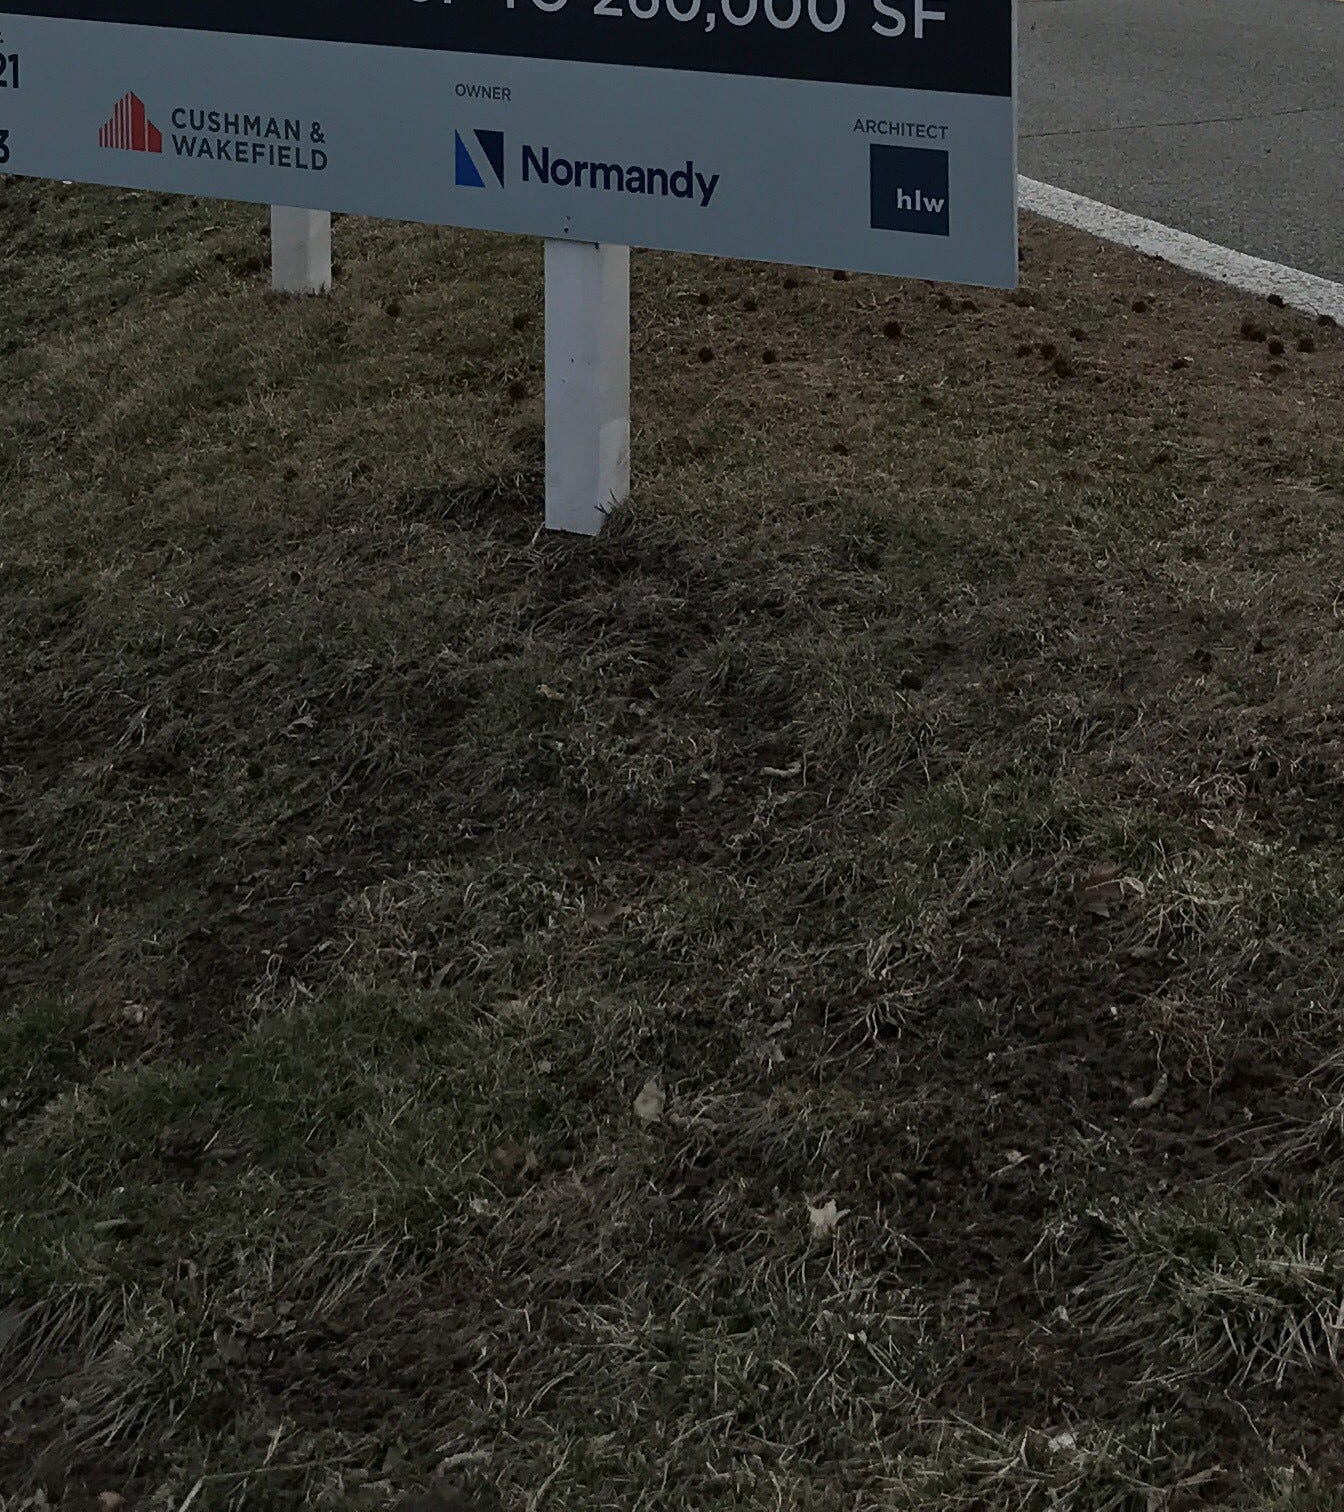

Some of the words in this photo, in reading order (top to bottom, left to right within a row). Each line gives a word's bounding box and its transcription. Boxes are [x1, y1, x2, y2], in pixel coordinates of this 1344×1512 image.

[455, 84, 511, 101] OWNER
[172, 108, 300, 141] CUSHMAN
[310, 122, 325, 143] &
[853, 119, 948, 139] ARCHITECT
[172, 134, 327, 170] WAKEFIELD
[522, 145, 719, 207] Normandy
[897, 188, 944, 212] hlw
